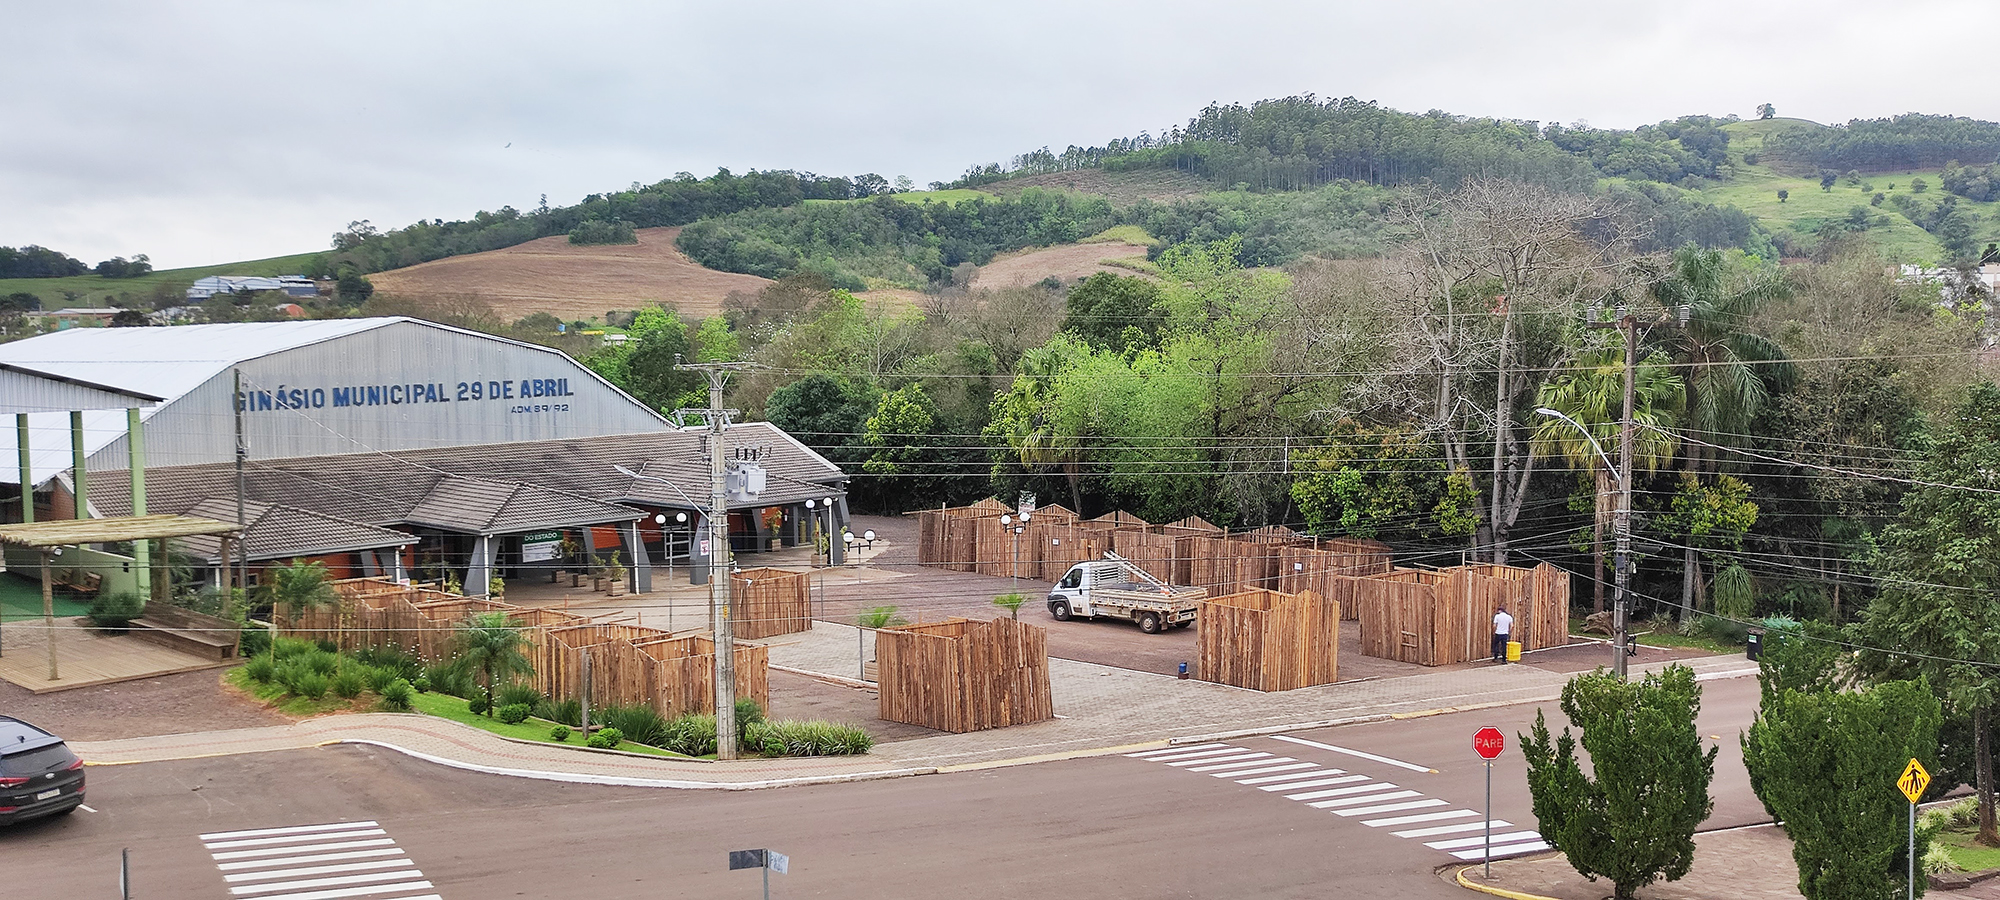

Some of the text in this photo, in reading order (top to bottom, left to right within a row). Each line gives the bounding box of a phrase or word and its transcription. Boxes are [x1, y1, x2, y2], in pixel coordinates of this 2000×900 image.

[232, 378, 574, 412] GINÁSIO MUNICIPAL 29 DE ABRIL
[535, 532, 557, 540] ESTADO
[1475, 737, 1503, 748] PARE
